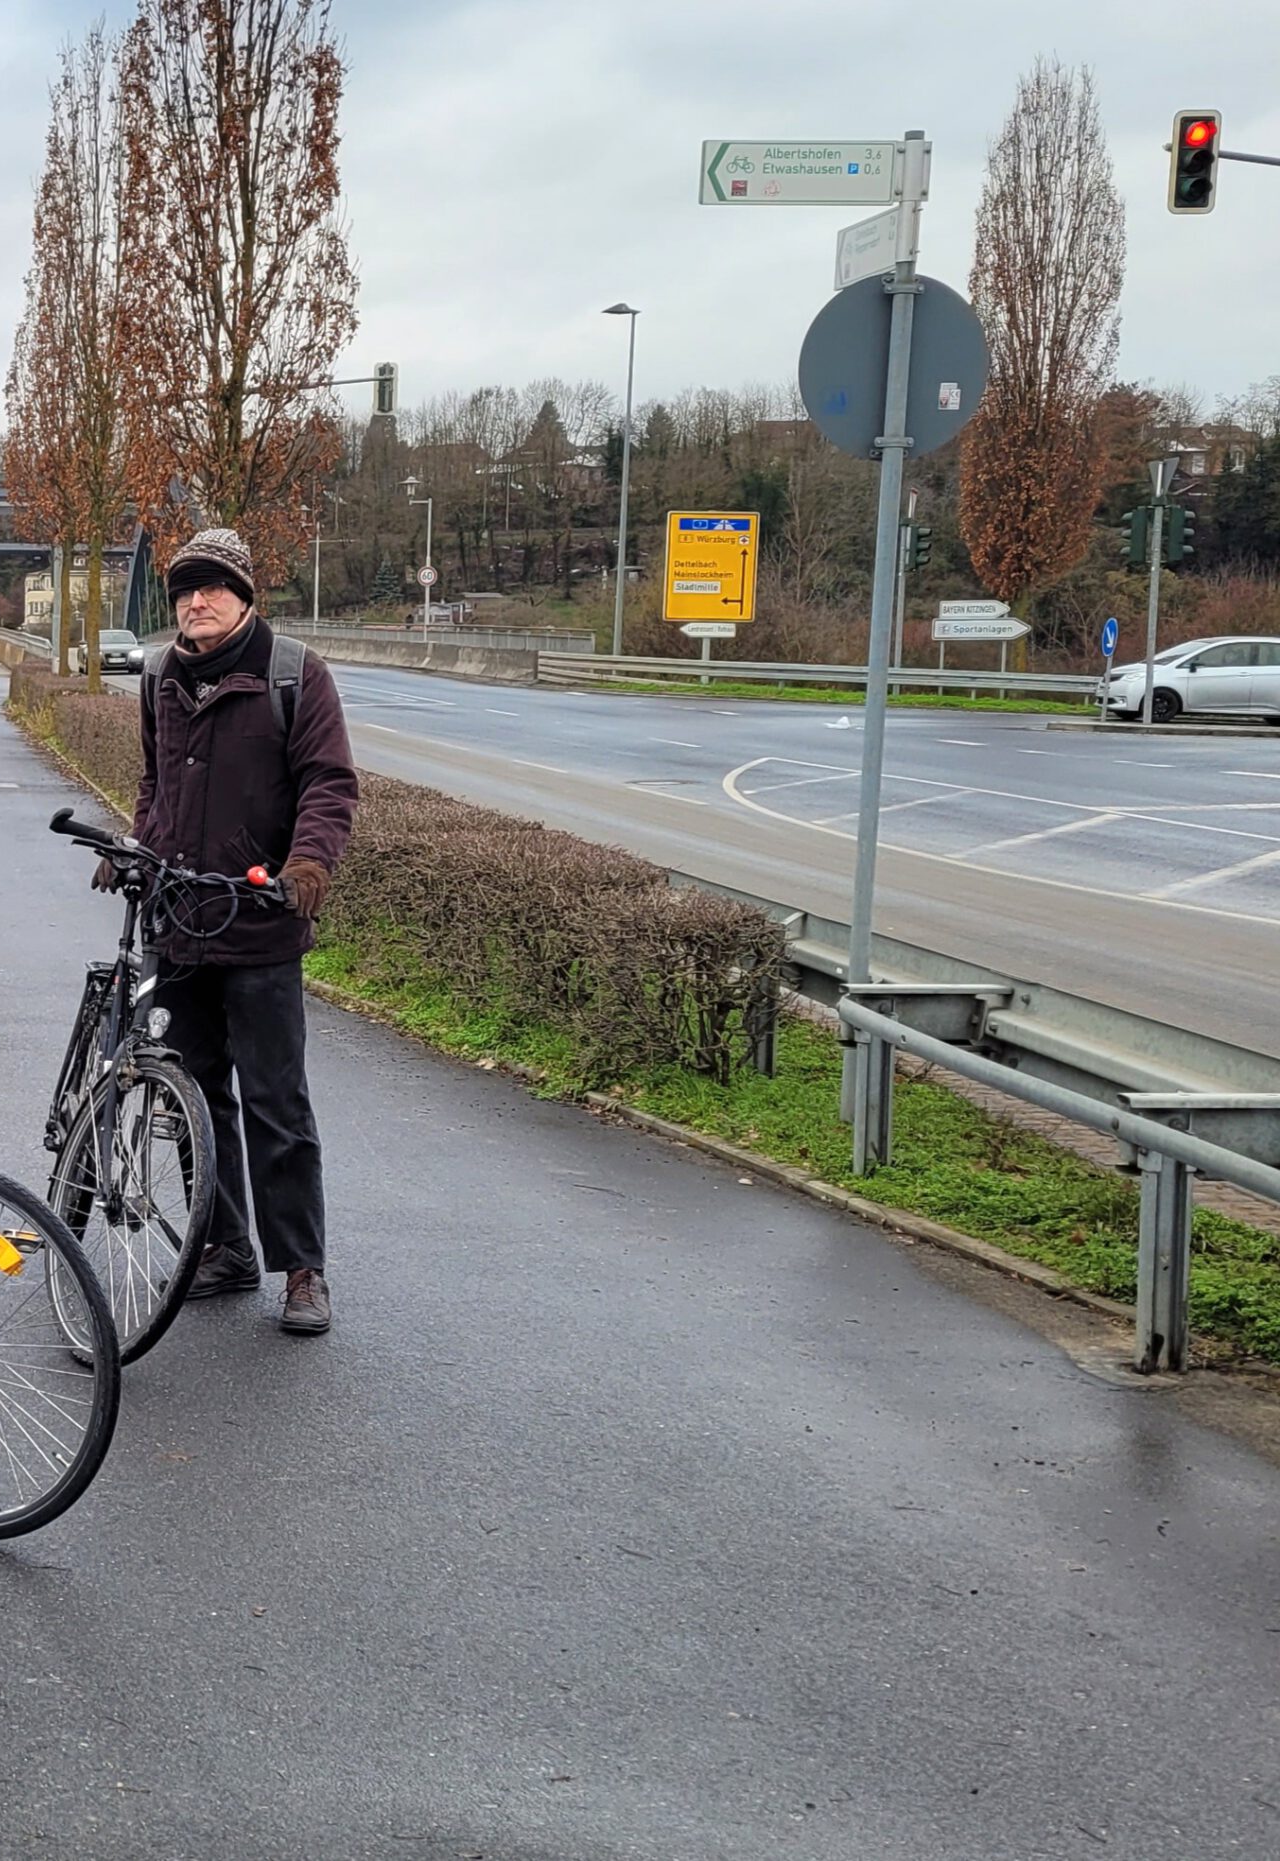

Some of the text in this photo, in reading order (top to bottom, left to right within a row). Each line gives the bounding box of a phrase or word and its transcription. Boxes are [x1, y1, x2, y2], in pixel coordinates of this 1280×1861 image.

[763, 148, 882, 161] Albertshofen 3,6
[762, 162, 843, 175] Etwashausen
[863, 162, 881, 175] 0,6
[696, 535, 736, 545] Würzburg
[674, 560, 718, 568] Dettelbach
[422, 571, 433, 580] 60
[674, 570, 734, 579] Mainstockheim
[675, 582, 719, 592] Stadtmitte
[953, 625, 1013, 635] Sportanlagen
